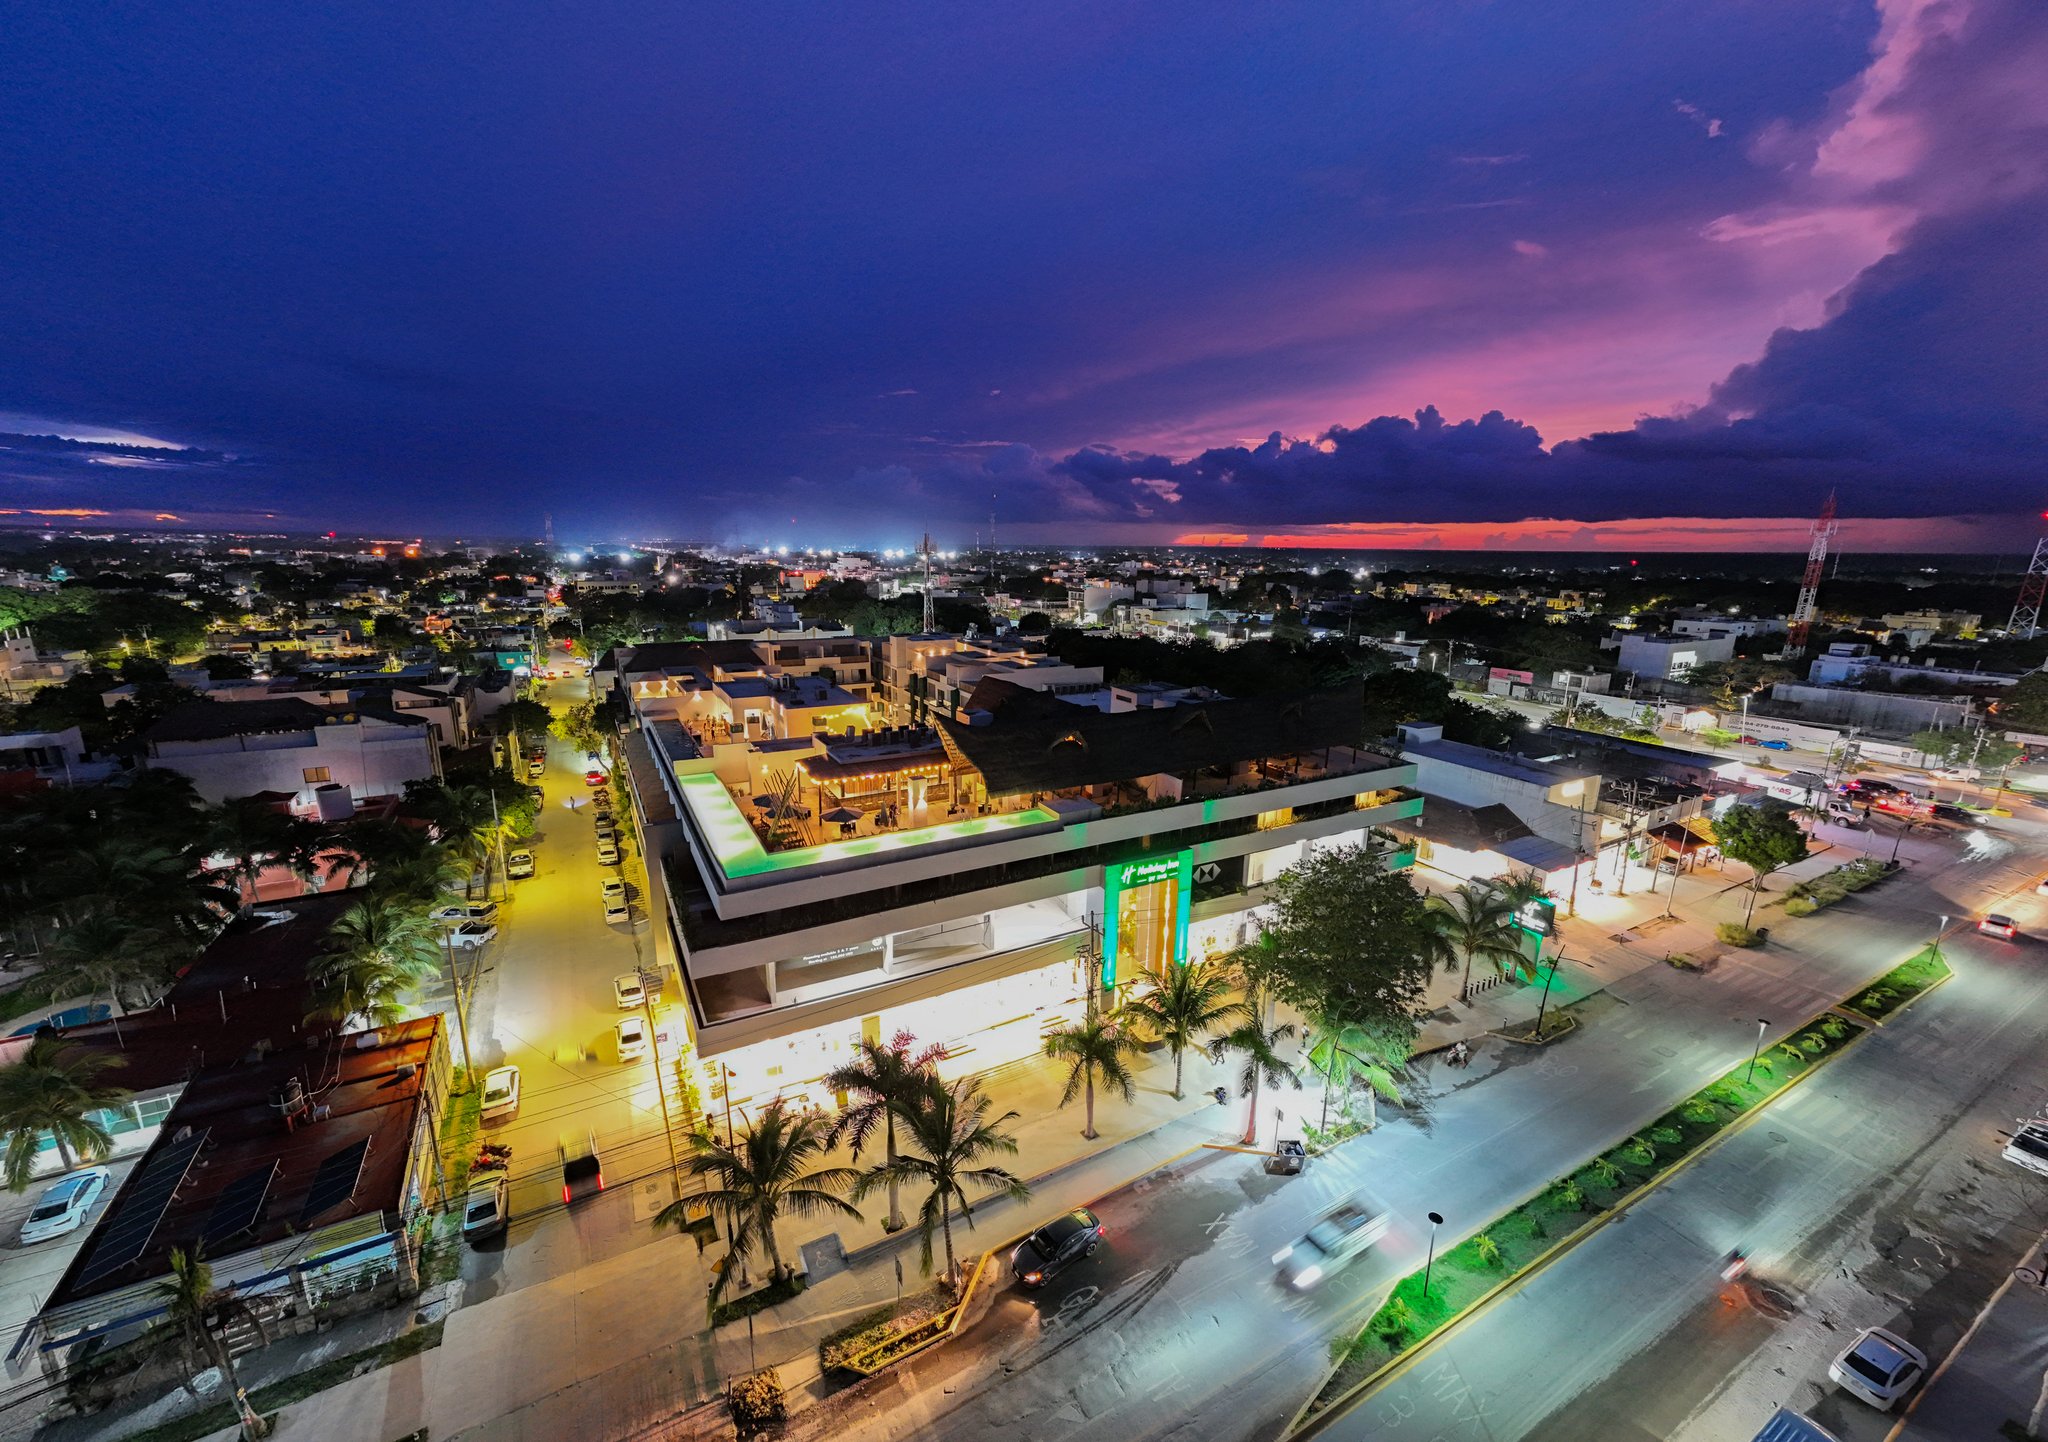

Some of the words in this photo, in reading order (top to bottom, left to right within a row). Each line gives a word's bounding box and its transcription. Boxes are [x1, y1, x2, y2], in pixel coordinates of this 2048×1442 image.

[1137, 862, 1167, 876] Holiday
[1167, 859, 1180, 869] Inn
[1420, 1361, 1499, 1436] MAX
